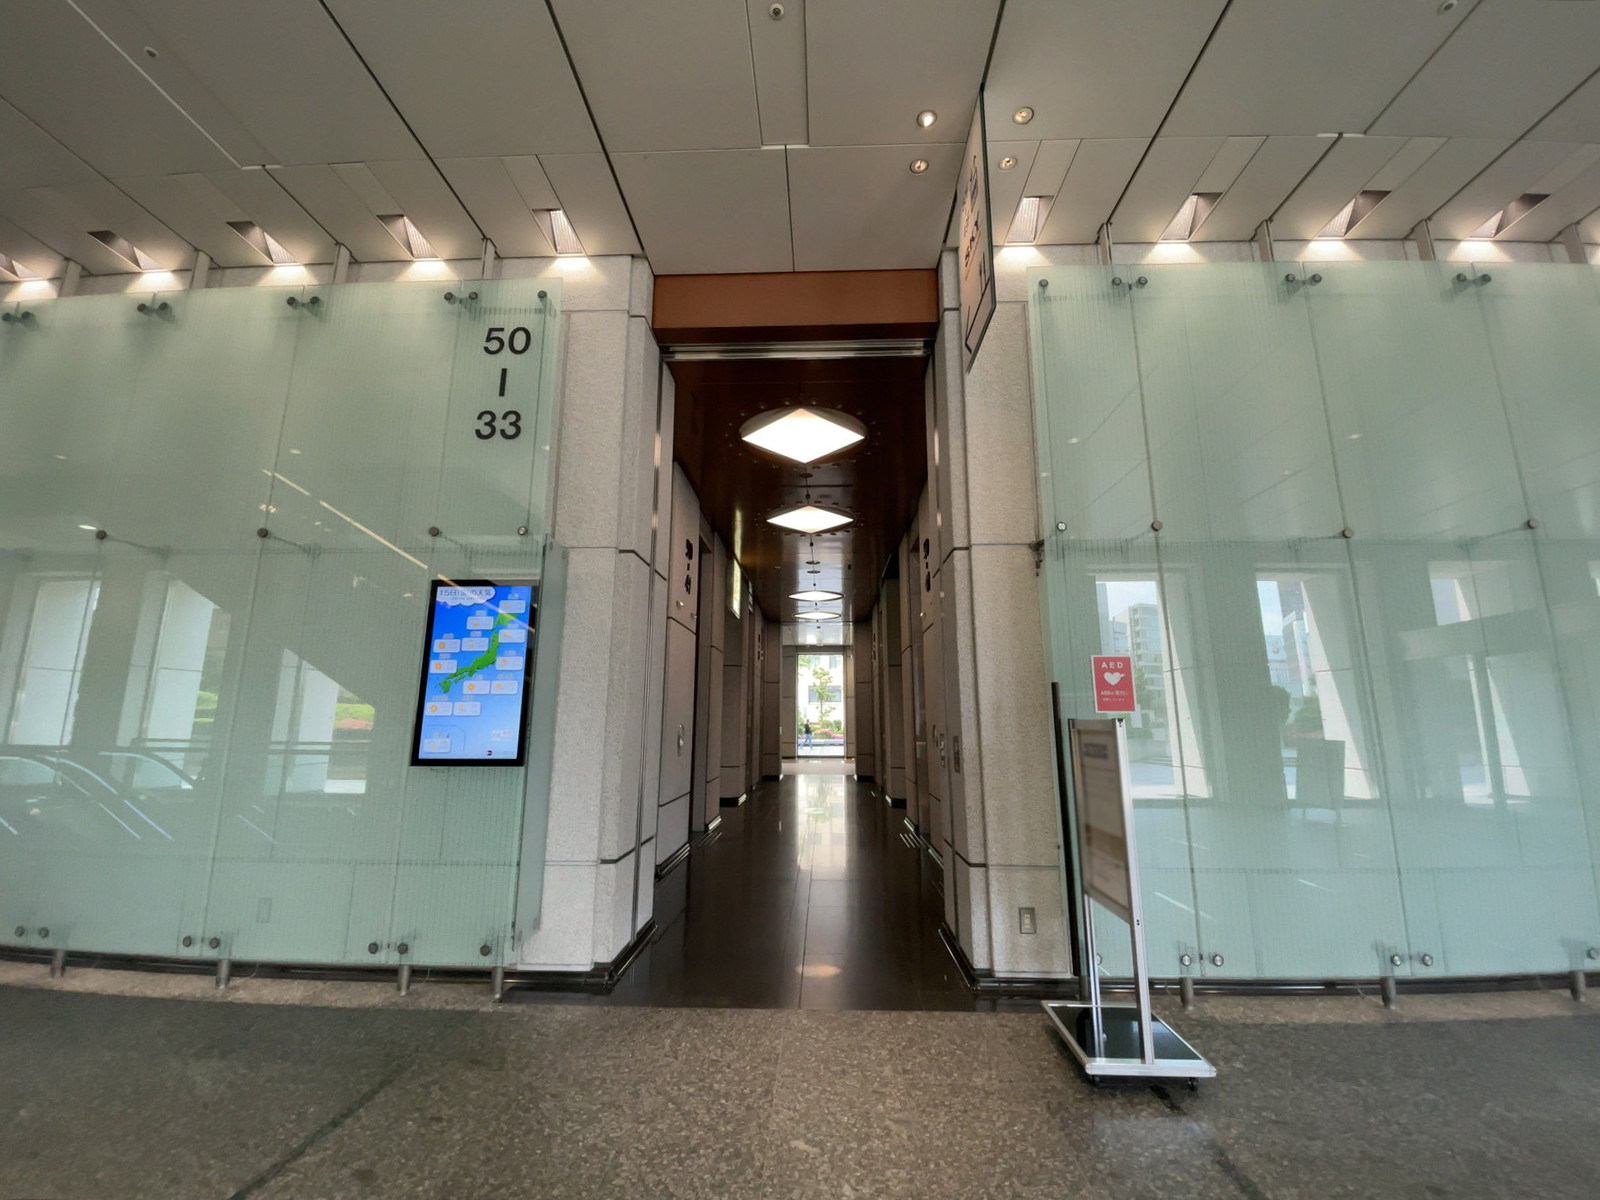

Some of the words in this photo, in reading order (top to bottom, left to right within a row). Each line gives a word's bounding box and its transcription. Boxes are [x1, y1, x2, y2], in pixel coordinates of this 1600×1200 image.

[483, 326, 532, 355] 50
[475, 410, 522, 440] 33
[1101, 661, 1123, 669] AED
